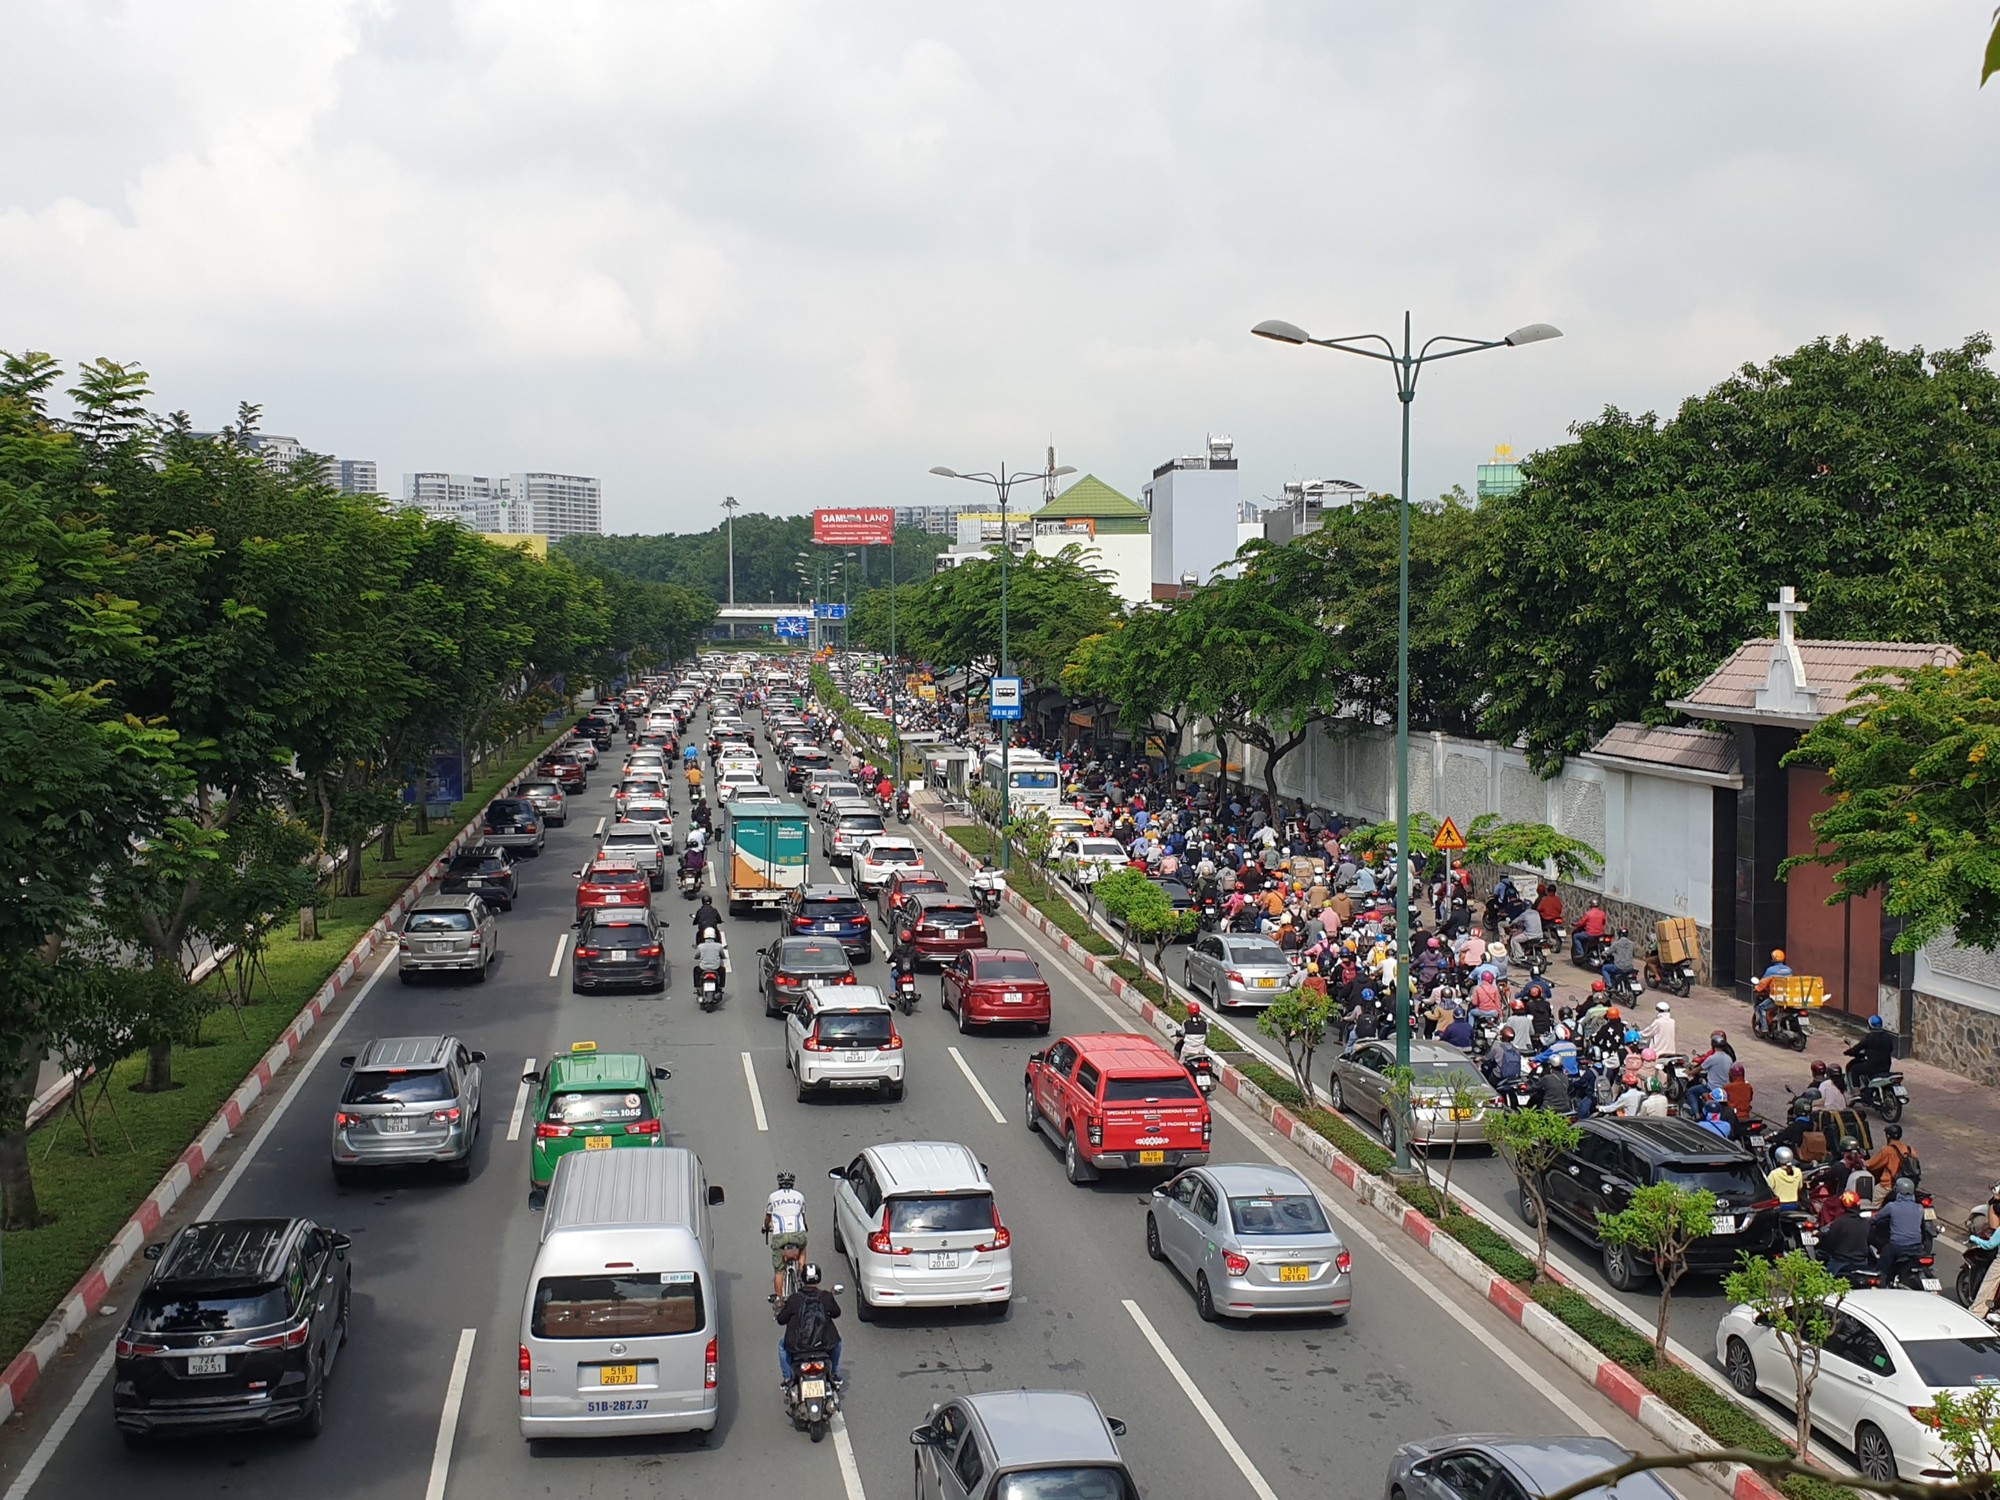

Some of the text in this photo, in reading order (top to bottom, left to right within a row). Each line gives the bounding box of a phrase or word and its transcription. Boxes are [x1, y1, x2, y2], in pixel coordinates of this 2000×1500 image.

[864, 514, 889, 522] LAND
[773, 1198, 801, 1208] ITALIA
[199, 1355, 215, 1364] 72A
[611, 1366, 627, 1375] 51B
[604, 1375, 633, 1384] 287.37
[588, 1399, 649, 1412] 51B-287.37
